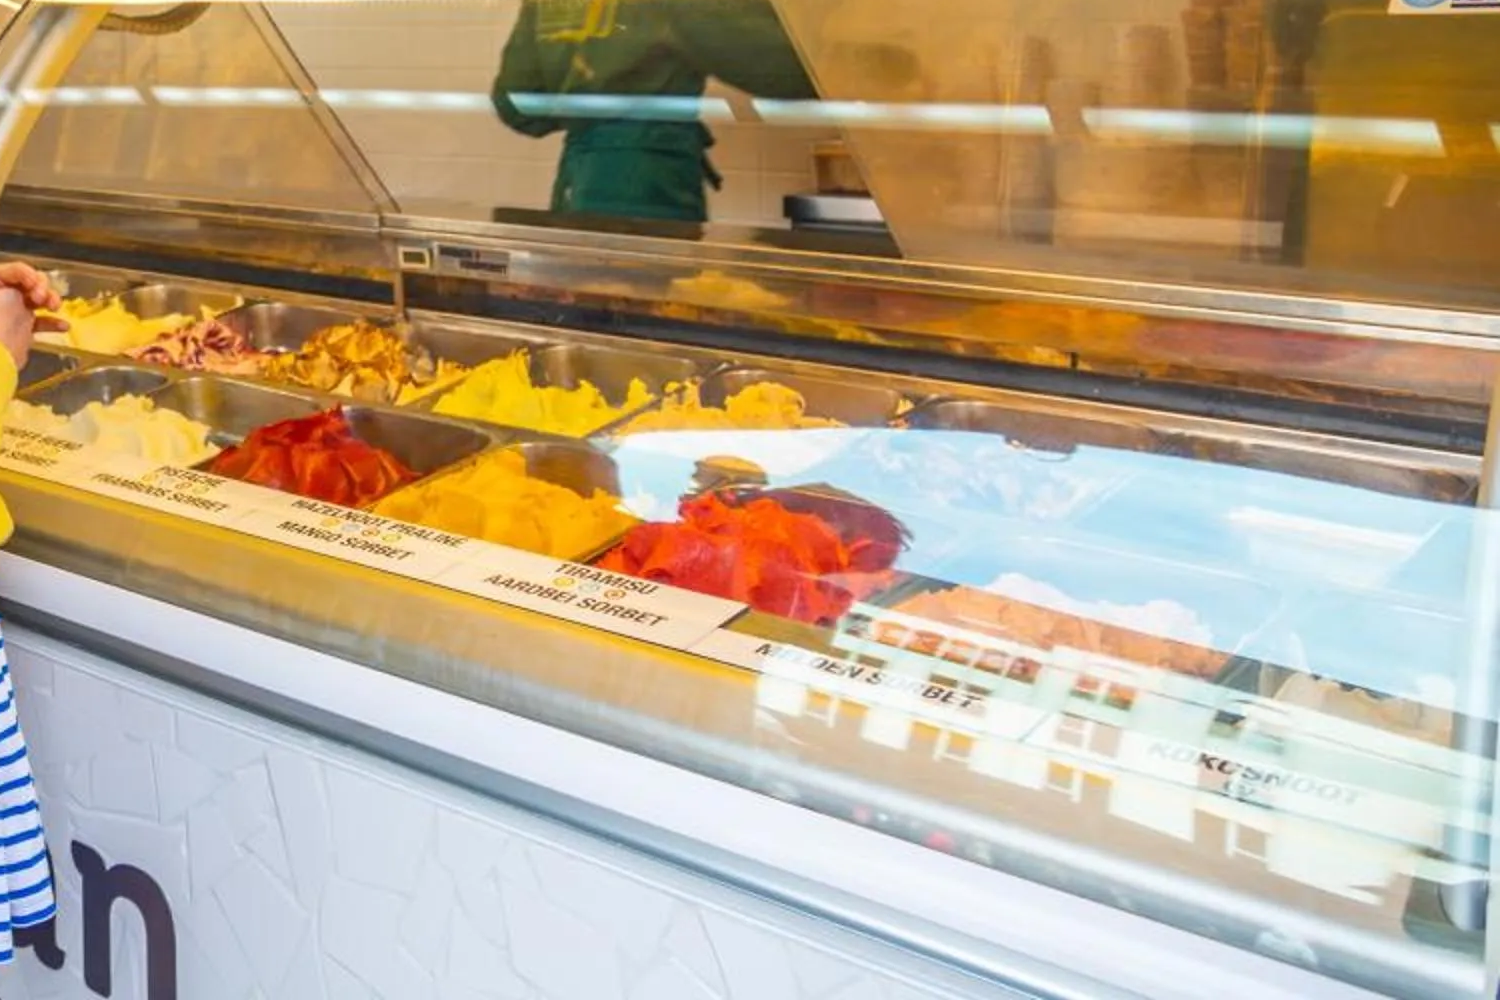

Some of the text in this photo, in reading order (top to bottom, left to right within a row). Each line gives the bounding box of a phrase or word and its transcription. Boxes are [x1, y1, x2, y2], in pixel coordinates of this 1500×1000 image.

[167, 492, 230, 513] SORBET
[277, 521, 416, 561] MANGO SORBET
[291, 499, 468, 549] HAZELNOOT PRALINE
[555, 563, 660, 596] TIRAMISU
[483, 574, 669, 628] AARDBEI SORBET
